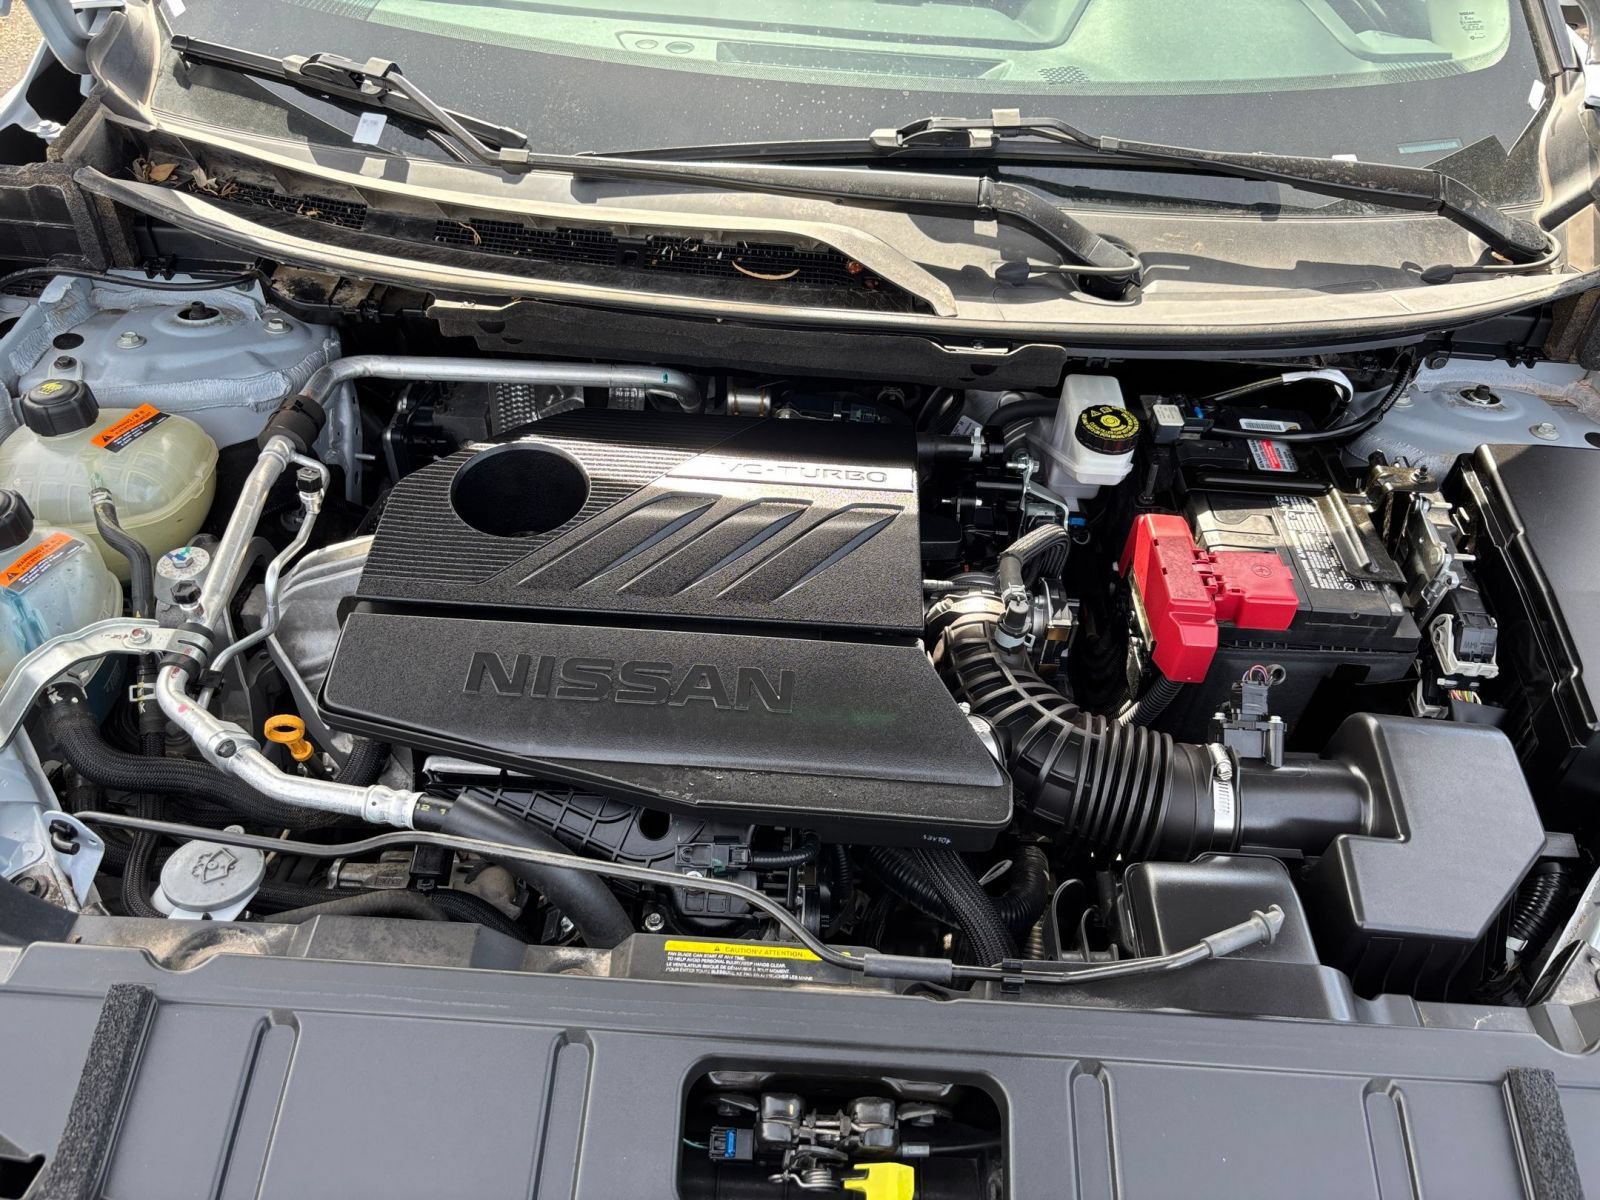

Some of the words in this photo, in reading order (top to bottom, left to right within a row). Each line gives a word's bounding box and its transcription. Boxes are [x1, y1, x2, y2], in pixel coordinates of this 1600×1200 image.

[721, 461, 888, 483] VC-TURBO
[463, 651, 796, 713] NISSAN
[764, 949, 803, 957] ATTENTION
